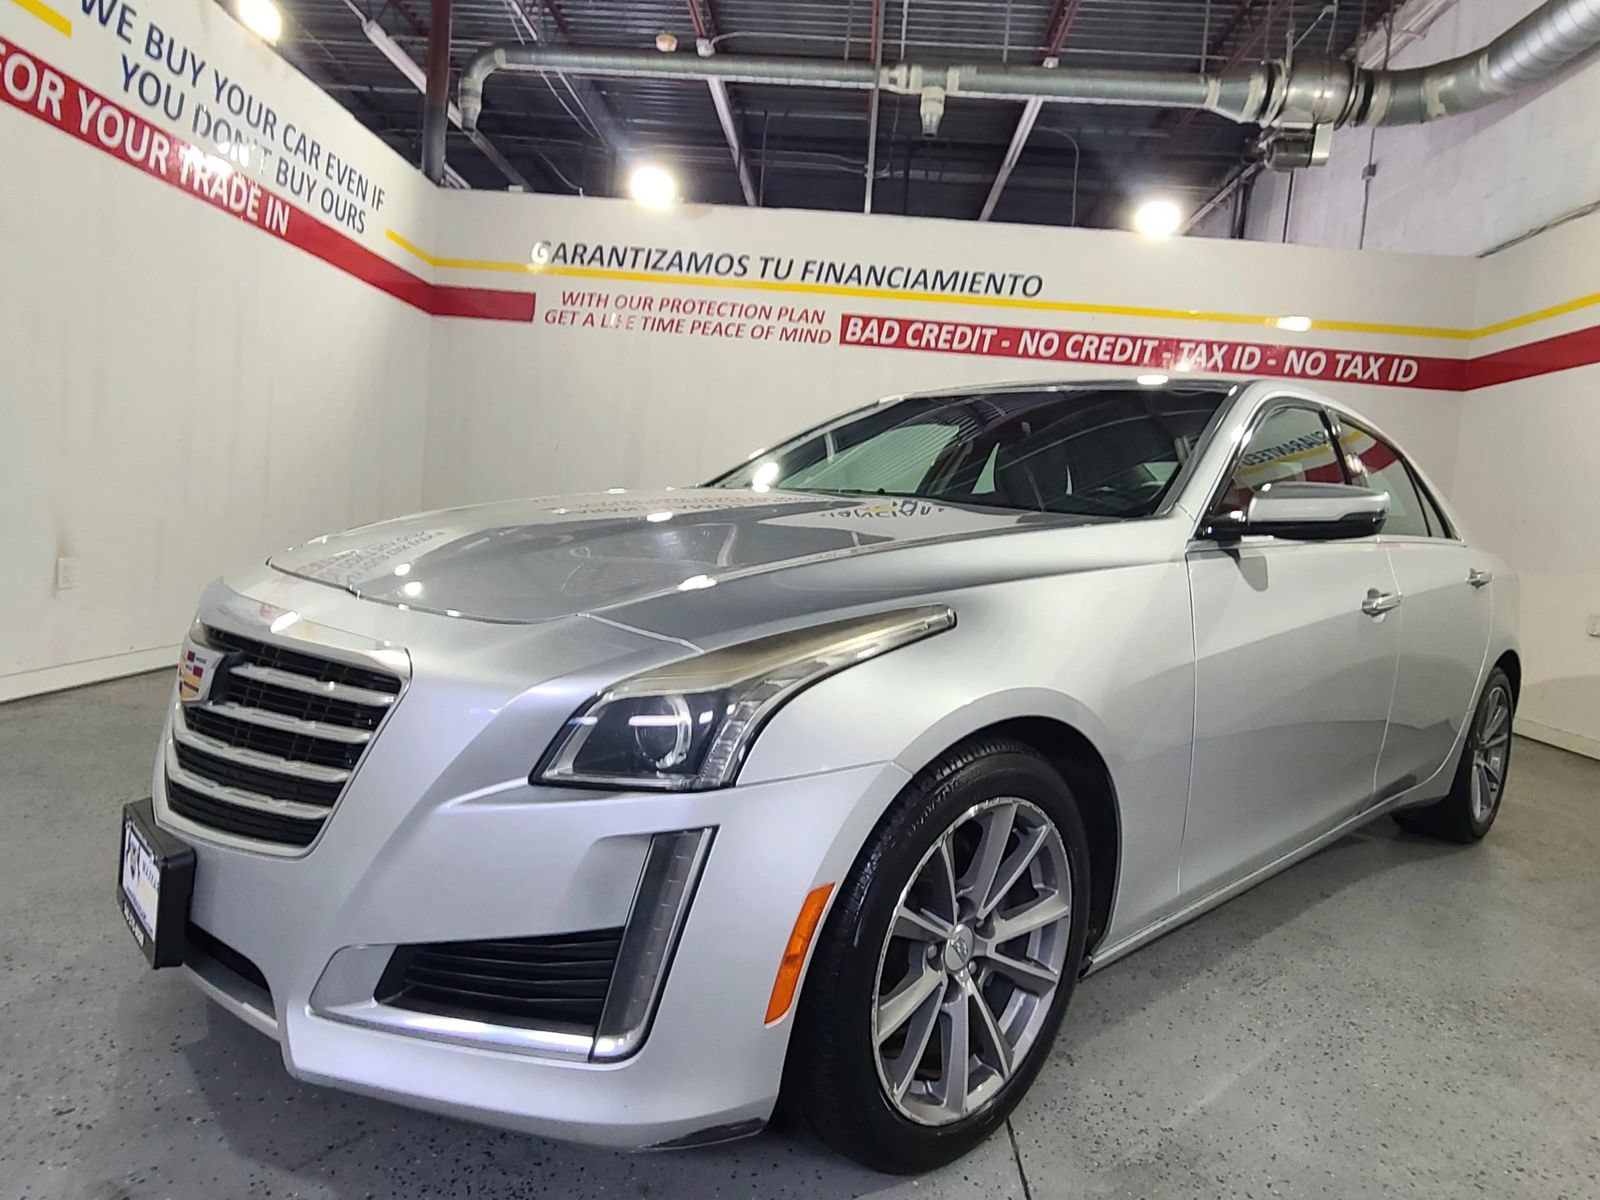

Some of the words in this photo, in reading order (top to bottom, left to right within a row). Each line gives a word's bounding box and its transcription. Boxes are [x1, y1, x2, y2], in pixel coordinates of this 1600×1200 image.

[81, 0, 137, 44] WE
[145, 22, 206, 88] BUY
[214, 68, 277, 141] YOUR
[283, 123, 320, 171] CAR
[325, 152, 368, 202] EVEN
[371, 184, 385, 211] IF
[78, 87, 170, 175] YOUR
[178, 144, 262, 221] TRADE
[265, 195, 290, 237] IN
[121, 53, 185, 121] YOU
[276, 156, 317, 203] BUY
[321, 187, 366, 234] OURS
[531, 240, 750, 278] GARANTIZAMOS
[759, 256, 793, 281] TU
[800, 259, 1043, 297] FINANCIAMIENTO
[544, 309, 580, 325] GET
[582, 312, 595, 328] A
[642, 316, 687, 334] TIME
[690, 318, 745, 339] PEACE
[750, 324, 776, 341] OF
[779, 327, 832, 345] MIND
[562, 291, 609, 309] WITH
[614, 294, 654, 312] OUR
[659, 297, 774, 321] PROTECTION
[777, 306, 826, 326] PLAN
[845, 317, 900, 346] BAD
[906, 321, 998, 353] CREDIT
[1017, 330, 1060, 358] NO
[1065, 334, 1159, 364] CREDIT
[1178, 341, 1229, 371] TAX
[1231, 345, 1261, 371] ID
[1283, 350, 1327, 376] NO
[1334, 353, 1385, 381] TAX
[1387, 358, 1419, 384] ID
